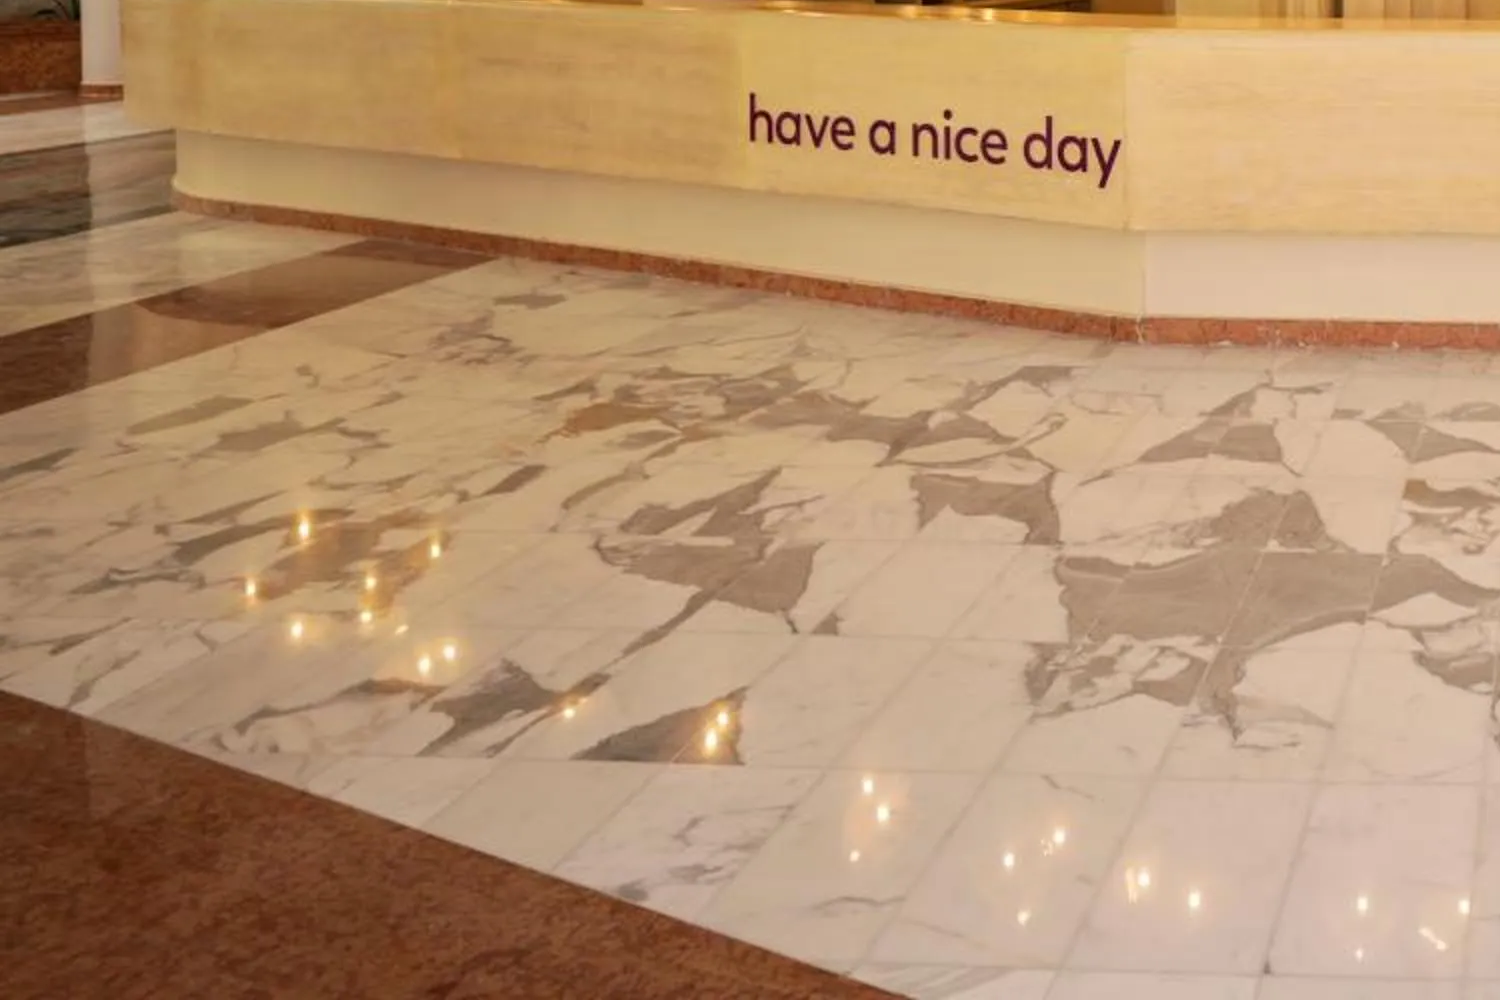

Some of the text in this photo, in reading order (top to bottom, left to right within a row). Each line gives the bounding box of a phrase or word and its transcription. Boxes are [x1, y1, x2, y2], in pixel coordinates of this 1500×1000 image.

[749, 92, 1122, 189] have a nice day
